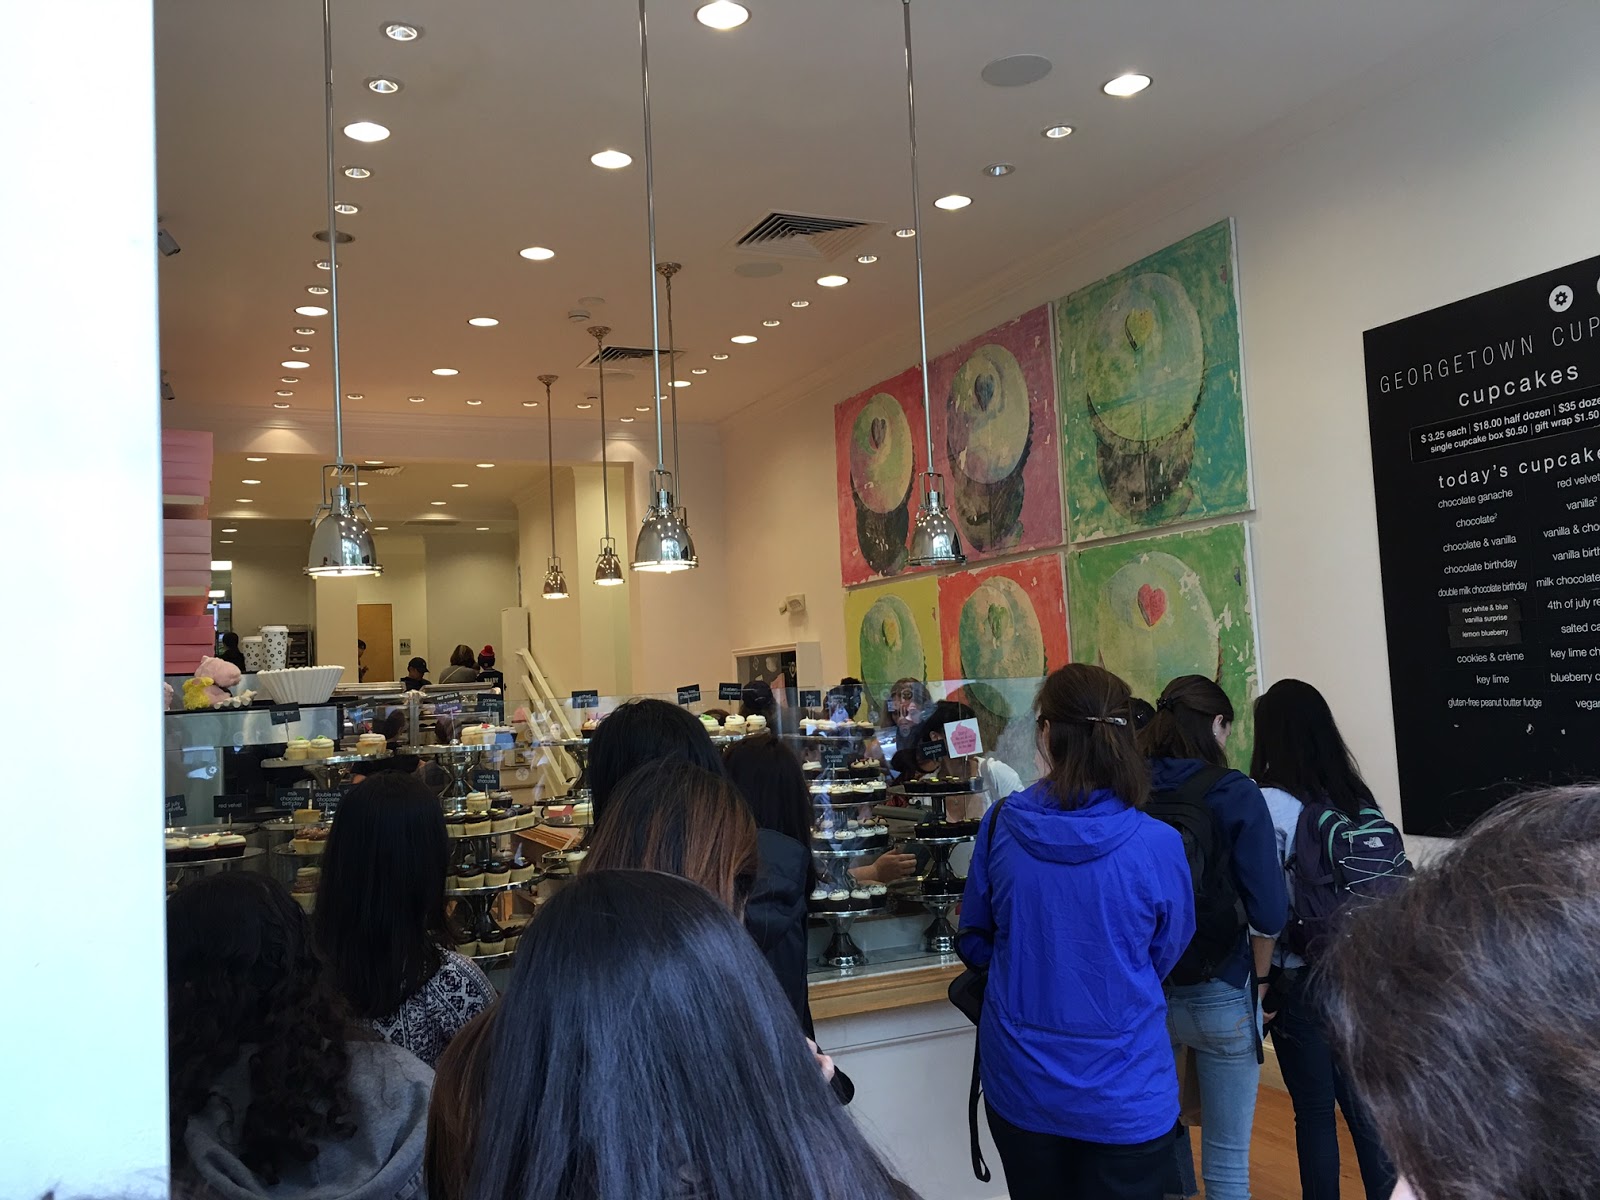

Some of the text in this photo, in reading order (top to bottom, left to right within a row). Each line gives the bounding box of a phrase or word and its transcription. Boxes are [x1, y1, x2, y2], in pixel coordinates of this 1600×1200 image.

[1380, 316, 1600, 393] GEORGETOWN CUP
[1459, 365, 1579, 407] cupcakes
[1446, 426, 1467, 438] each
[1473, 418, 1502, 432] $18.00
[1504, 413, 1521, 425] half
[1522, 408, 1551, 421] dozen
[1558, 401, 1576, 414] $35
[1430, 410, 1600, 453] single cupcake box $0.50 gift wrap $1.50
[1439, 465, 1508, 489] today's
[1557, 472, 1600, 488] red velvet
[1438, 489, 1513, 509] chocolate ganache
[1543, 526, 1570, 538] vanilla
[1572, 524, 1580, 534] &
[1443, 534, 1517, 553] chocolate & vanilla
[1552, 549, 1580, 561] vanilla
[1444, 558, 1518, 575] chocolate birthday
[1536, 572, 1600, 587] milk chocolate
[1438, 581, 1528, 597] double milk chocolate birthday
[1547, 600, 1562, 610] 4th
[1564, 598, 1574, 609] of
[1575, 597, 1591, 610] july
[1464, 614, 1508, 624] vanilla surprise
[1462, 628, 1509, 638] lemon blueberry
[1560, 622, 1588, 634] salted
[1456, 653, 1488, 664] cookies
[1490, 652, 1496, 662] &
[1550, 648, 1566, 660] key
[1568, 648, 1587, 658] lime
[1476, 674, 1510, 686] key lime
[1550, 672, 1593, 684] blueberry
[1448, 698, 1542, 709] gluten-free peanut butter fudge
